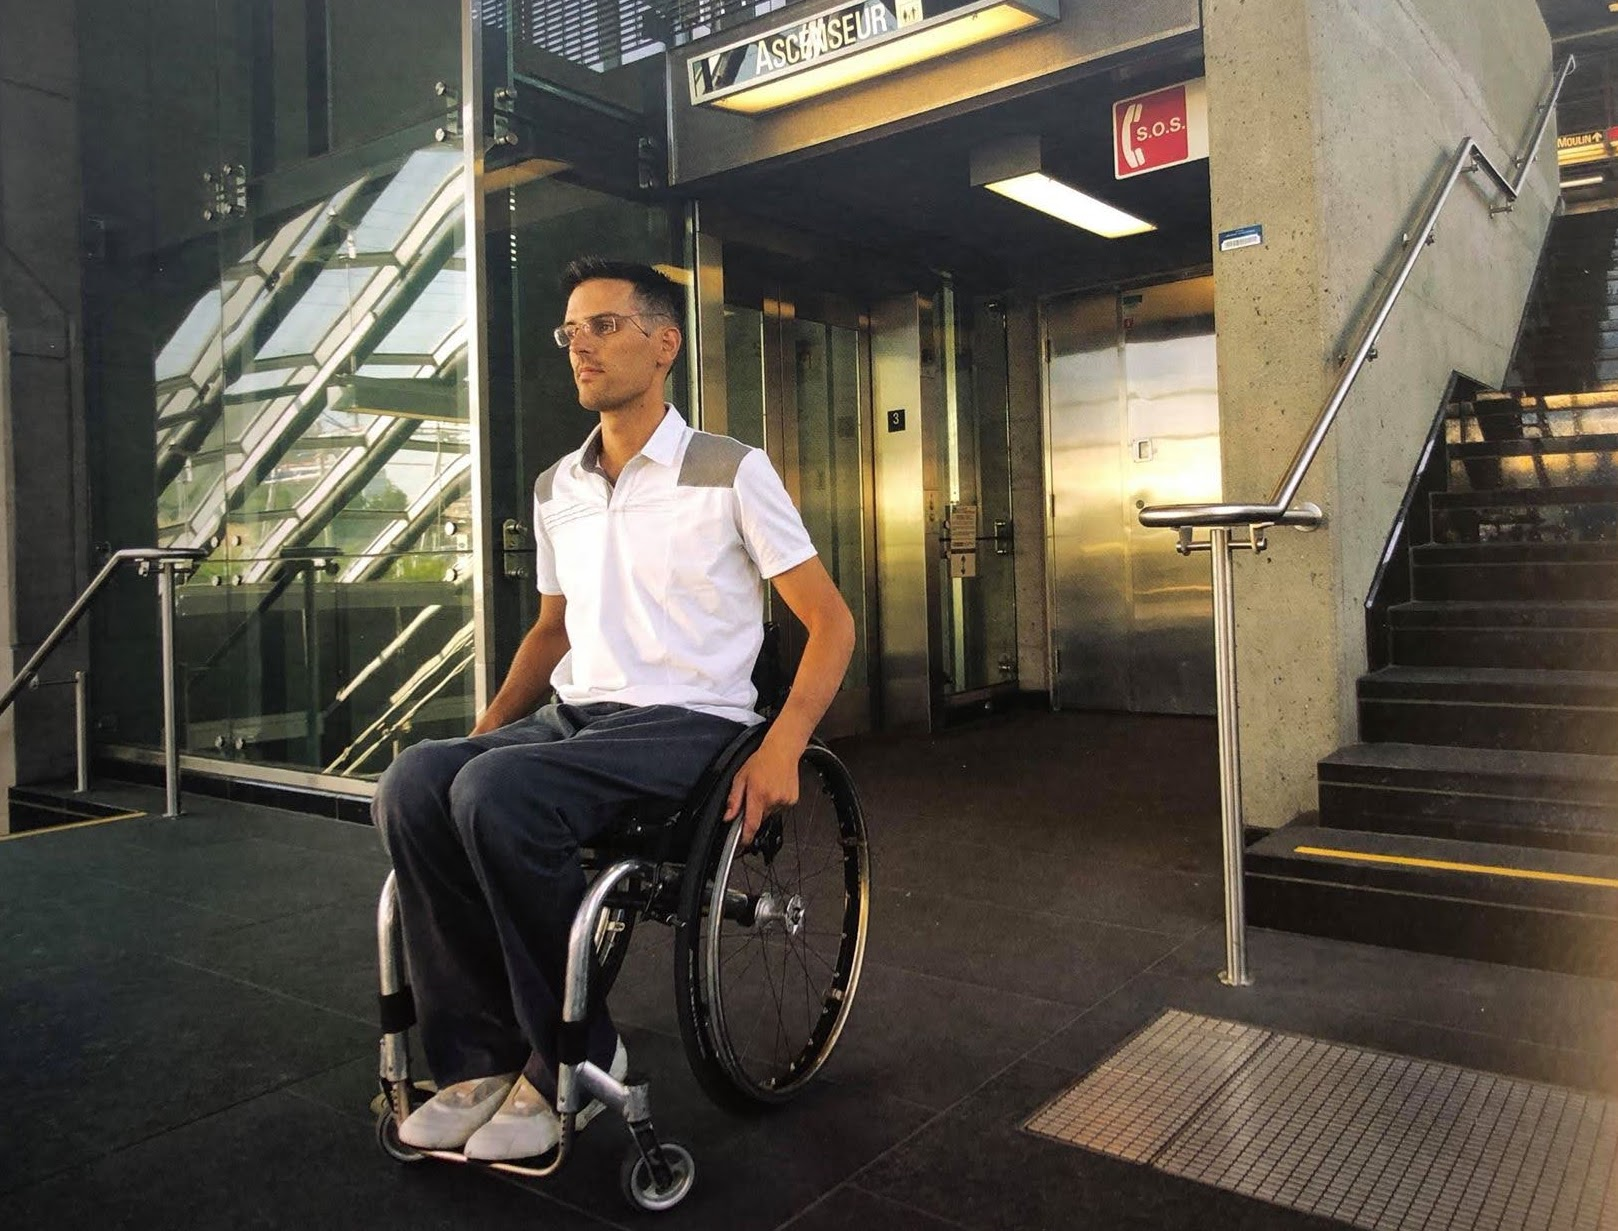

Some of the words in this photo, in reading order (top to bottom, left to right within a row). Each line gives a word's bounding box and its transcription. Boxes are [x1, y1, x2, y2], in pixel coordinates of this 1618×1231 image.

[1136, 117, 1186, 142] S.O.S.
[1557, 134, 1592, 148] MOULIN
[893, 412, 900, 425] 3
